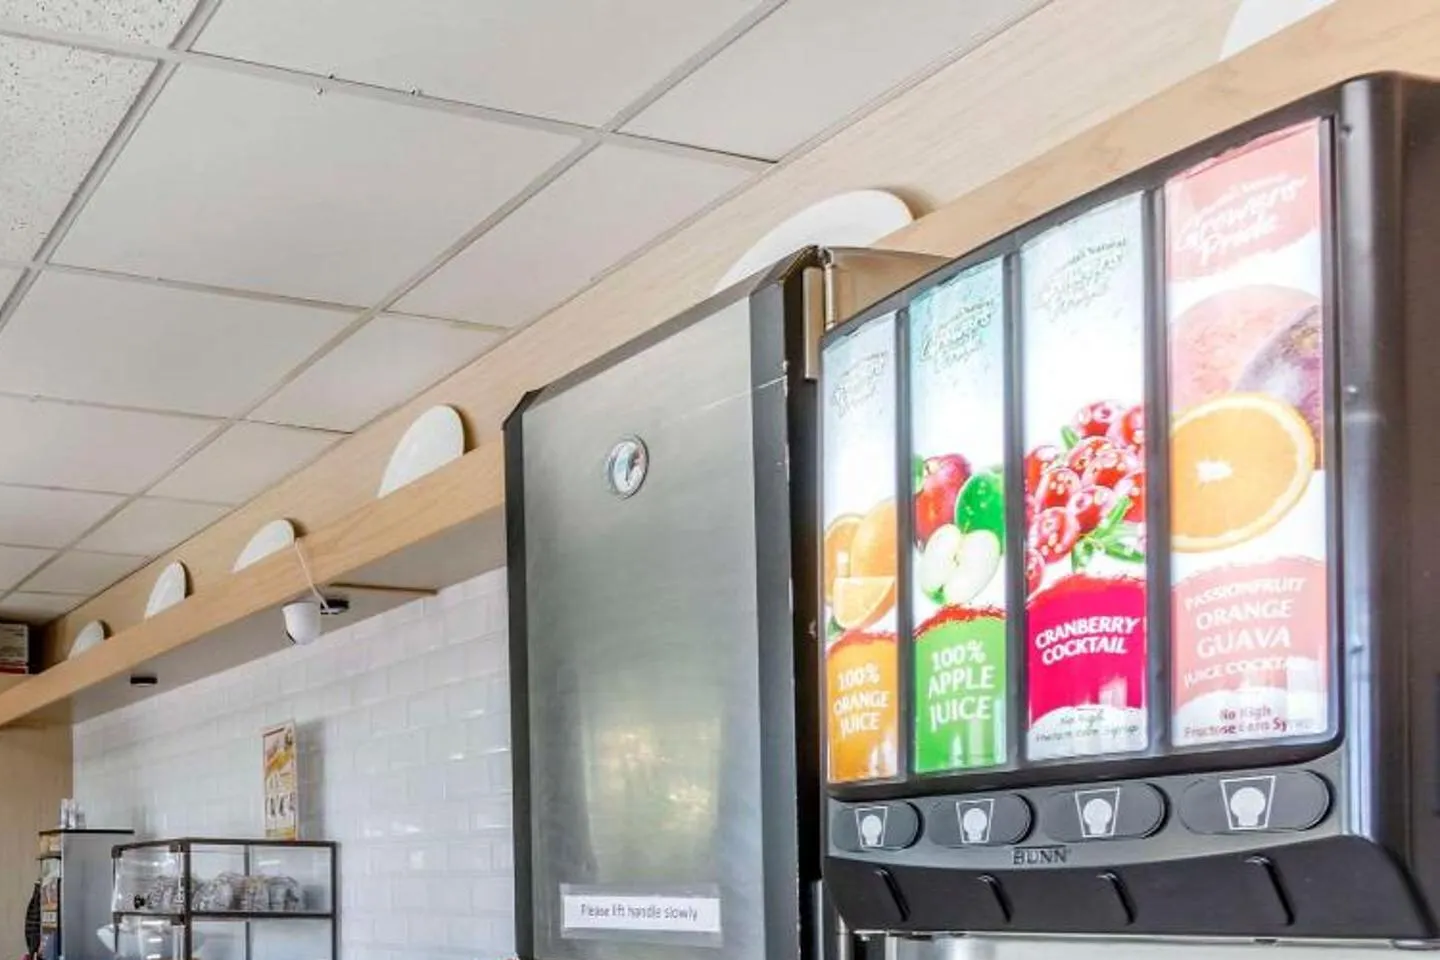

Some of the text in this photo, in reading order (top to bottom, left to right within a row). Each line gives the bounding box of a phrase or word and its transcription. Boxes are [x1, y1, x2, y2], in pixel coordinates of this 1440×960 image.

[1184, 577, 1305, 611] PASSIONFRUIT
[1196, 598, 1294, 630] ORANGE
[1035, 616, 1140, 649] CRANBERRY
[1196, 625, 1292, 658] GUAVA
[930, 640, 987, 672] 100%
[1042, 637, 1128, 666] COCKTAIL
[839, 663, 880, 692] 100%
[928, 666, 996, 699] APPLE
[1184, 664, 1222, 688] JUICE
[833, 690, 890, 716] ORANGE
[929, 696, 992, 733] JUICE
[840, 712, 881, 740] JUICE
[1013, 848, 1067, 865] BUNN
[580, 903, 698, 922] Please lift handle slowly
